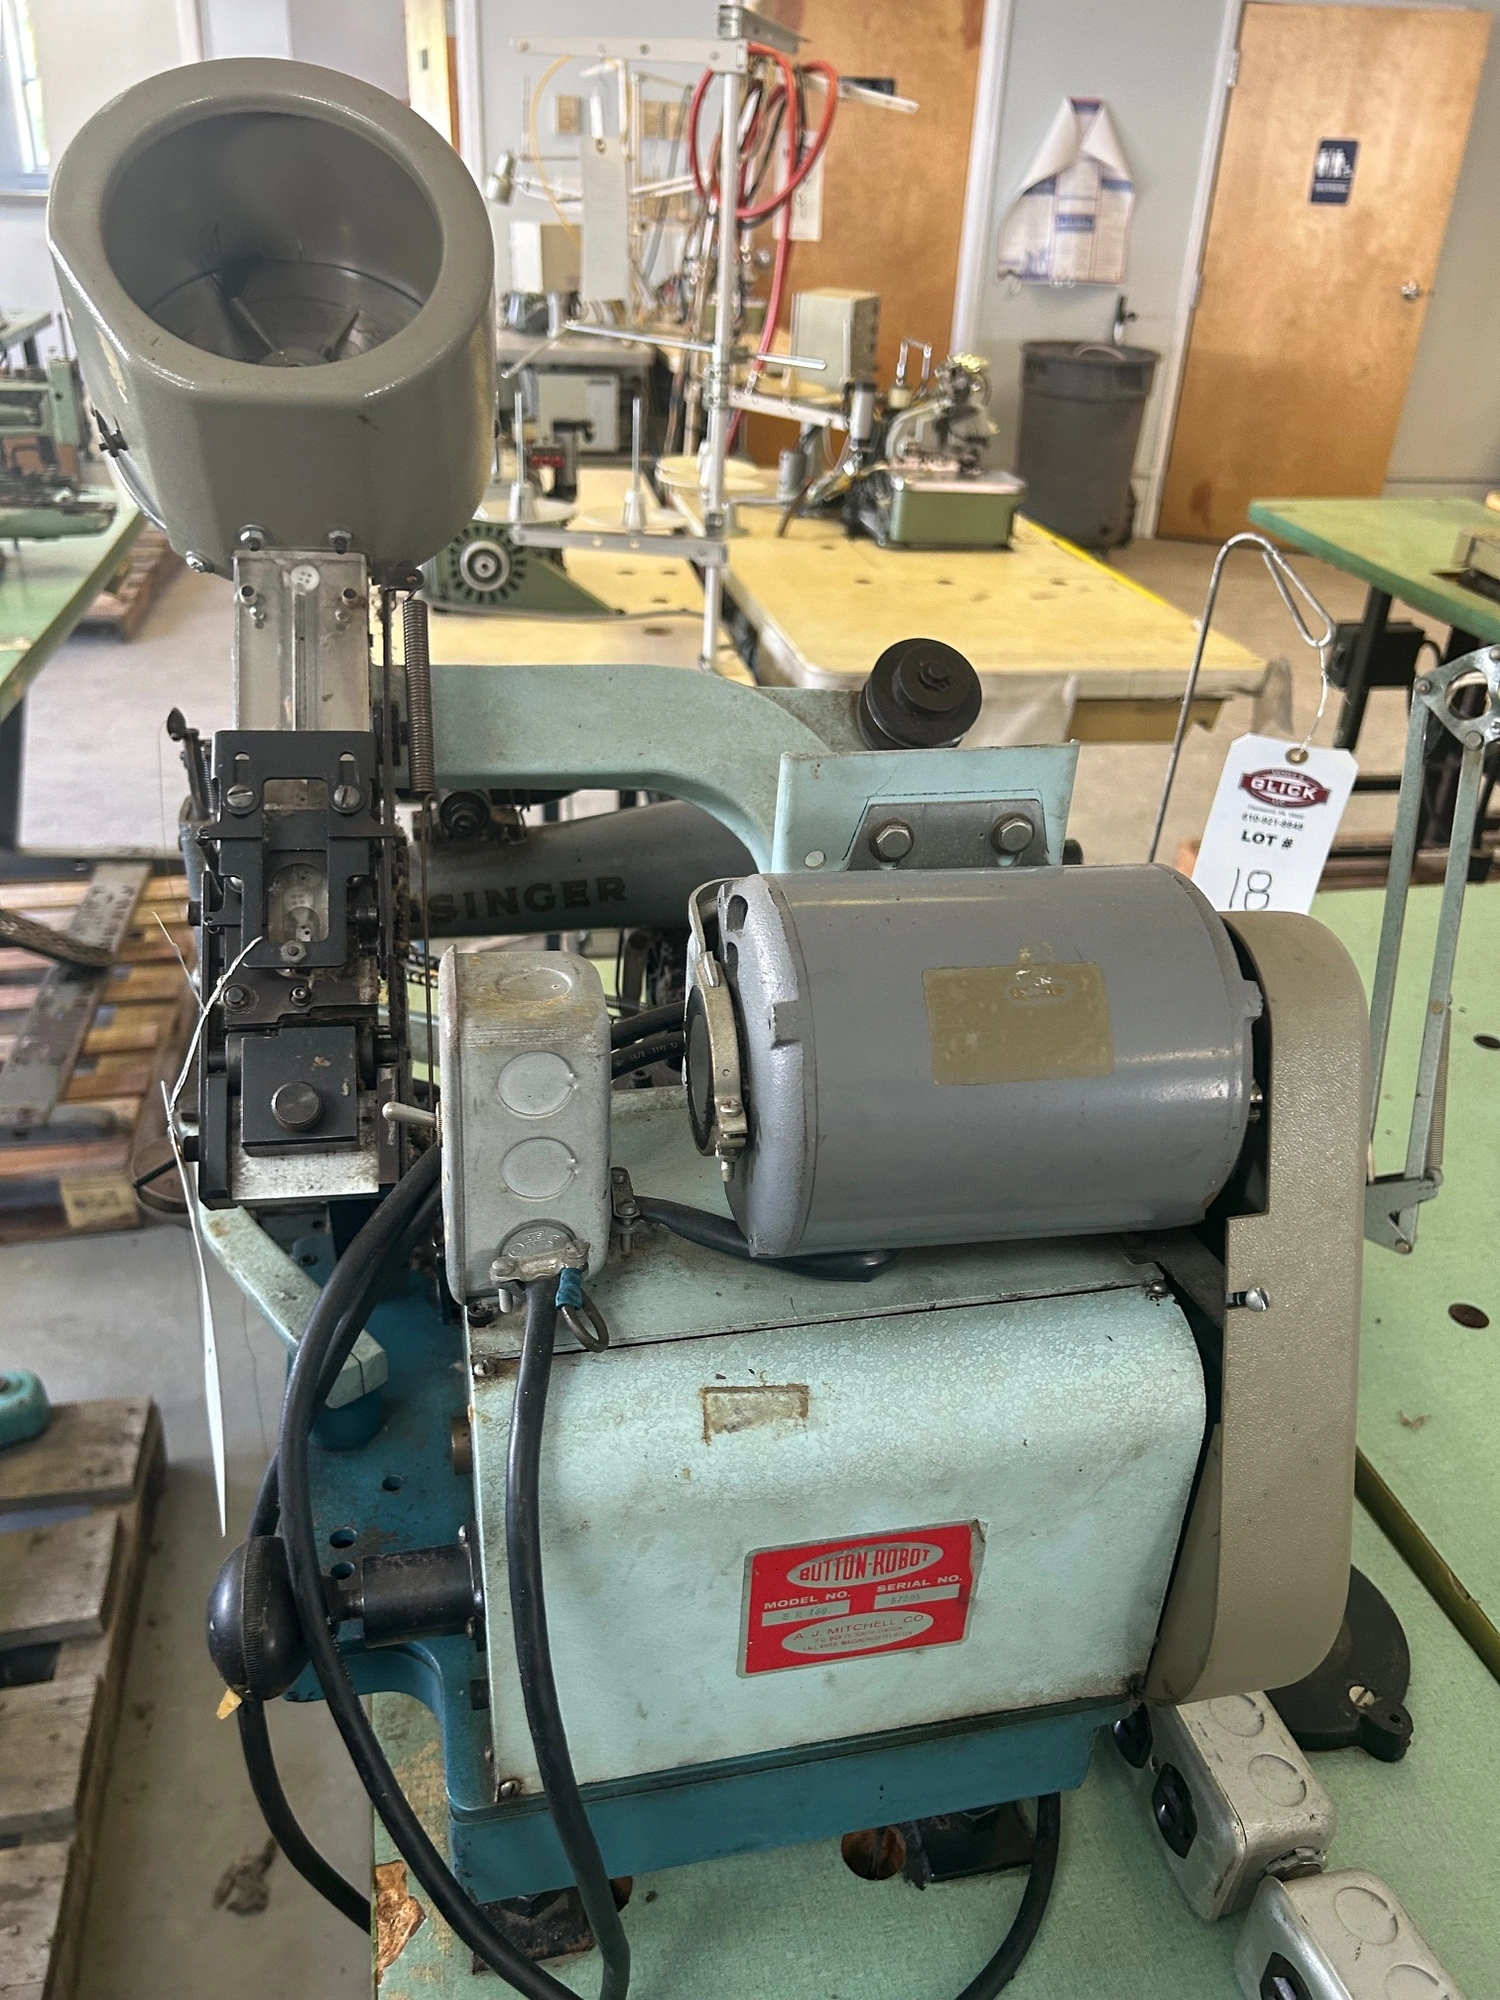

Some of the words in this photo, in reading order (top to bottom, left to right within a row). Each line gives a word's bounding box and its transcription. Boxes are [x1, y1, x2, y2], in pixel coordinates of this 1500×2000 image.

[1241, 830, 1277, 847] LOT
[1281, 836, 1295, 849] #
[427, 876, 627, 925] SINGER
[1229, 867, 1272, 911] 18
[799, 1549, 930, 1582] BUTTON-ROBOT
[876, 1579, 931, 1592] SERIAL
[937, 1574, 963, 1583] NO.
[764, 1596, 819, 1609] MODEL
[825, 1590, 851, 1601] NO.
[794, 1632, 804, 1640] A
[827, 1619, 896, 1635] MITCHELL
[903, 1614, 924, 1623] CO
